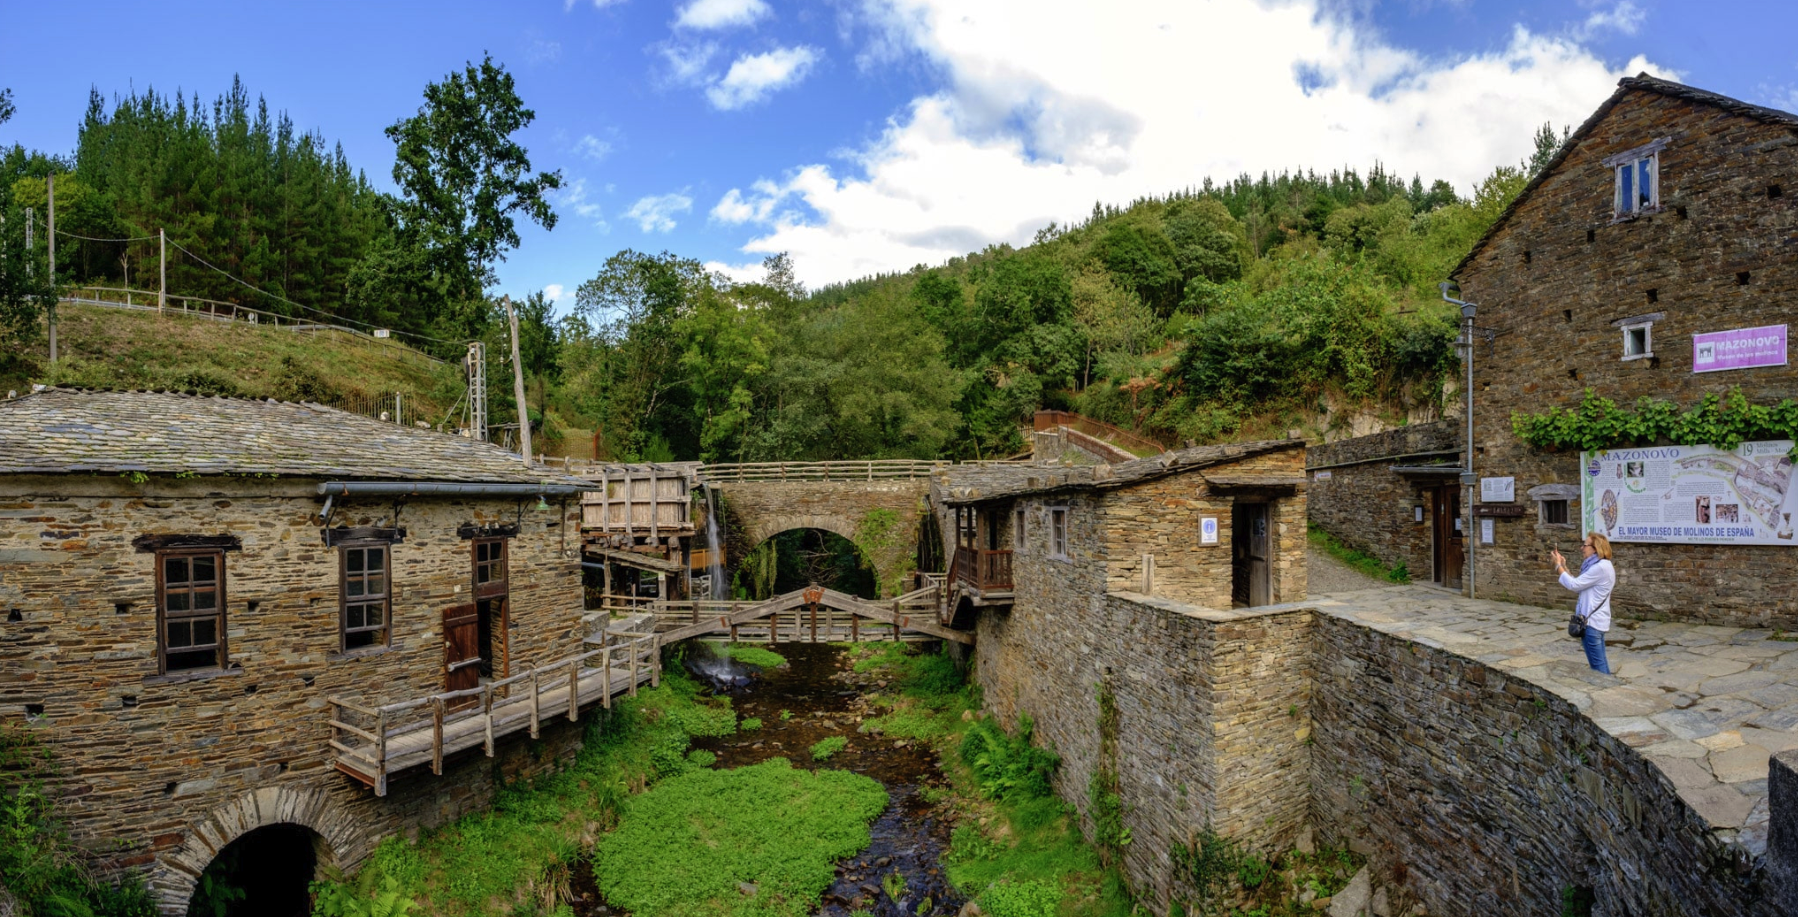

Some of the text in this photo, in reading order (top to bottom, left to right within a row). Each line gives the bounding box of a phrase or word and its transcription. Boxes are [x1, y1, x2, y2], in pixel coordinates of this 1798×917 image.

[1716, 335, 1779, 350] MAZONOVO
[1602, 448, 1680, 461] MAZONOVO
[1743, 443, 1754, 456] 19
[1618, 526, 1755, 537] EL MAYOR MUSEO DE MOLINOS DE ESPAÑA
